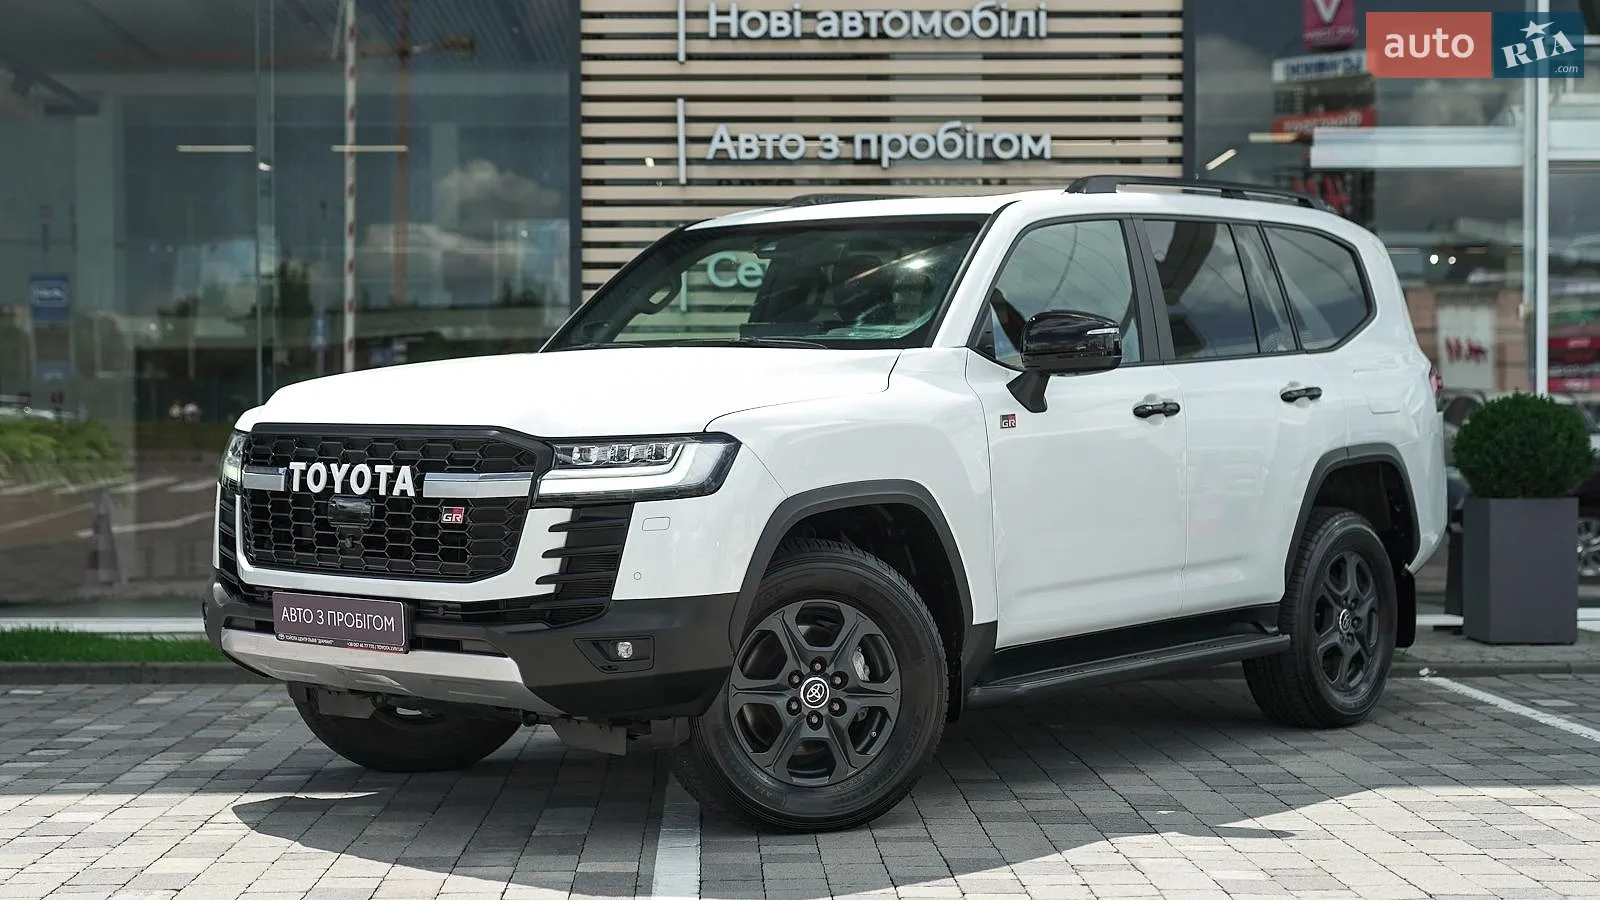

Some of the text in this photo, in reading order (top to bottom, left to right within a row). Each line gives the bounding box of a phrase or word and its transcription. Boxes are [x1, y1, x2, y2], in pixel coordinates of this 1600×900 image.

[708, 1, 1048, 38] Нові автомобілі
[706, 120, 1053, 169] Авто з пробігом
[289, 461, 416, 497] TOYOTA
[281, 606, 395, 632] АВТО З ПРОБІГОМ
